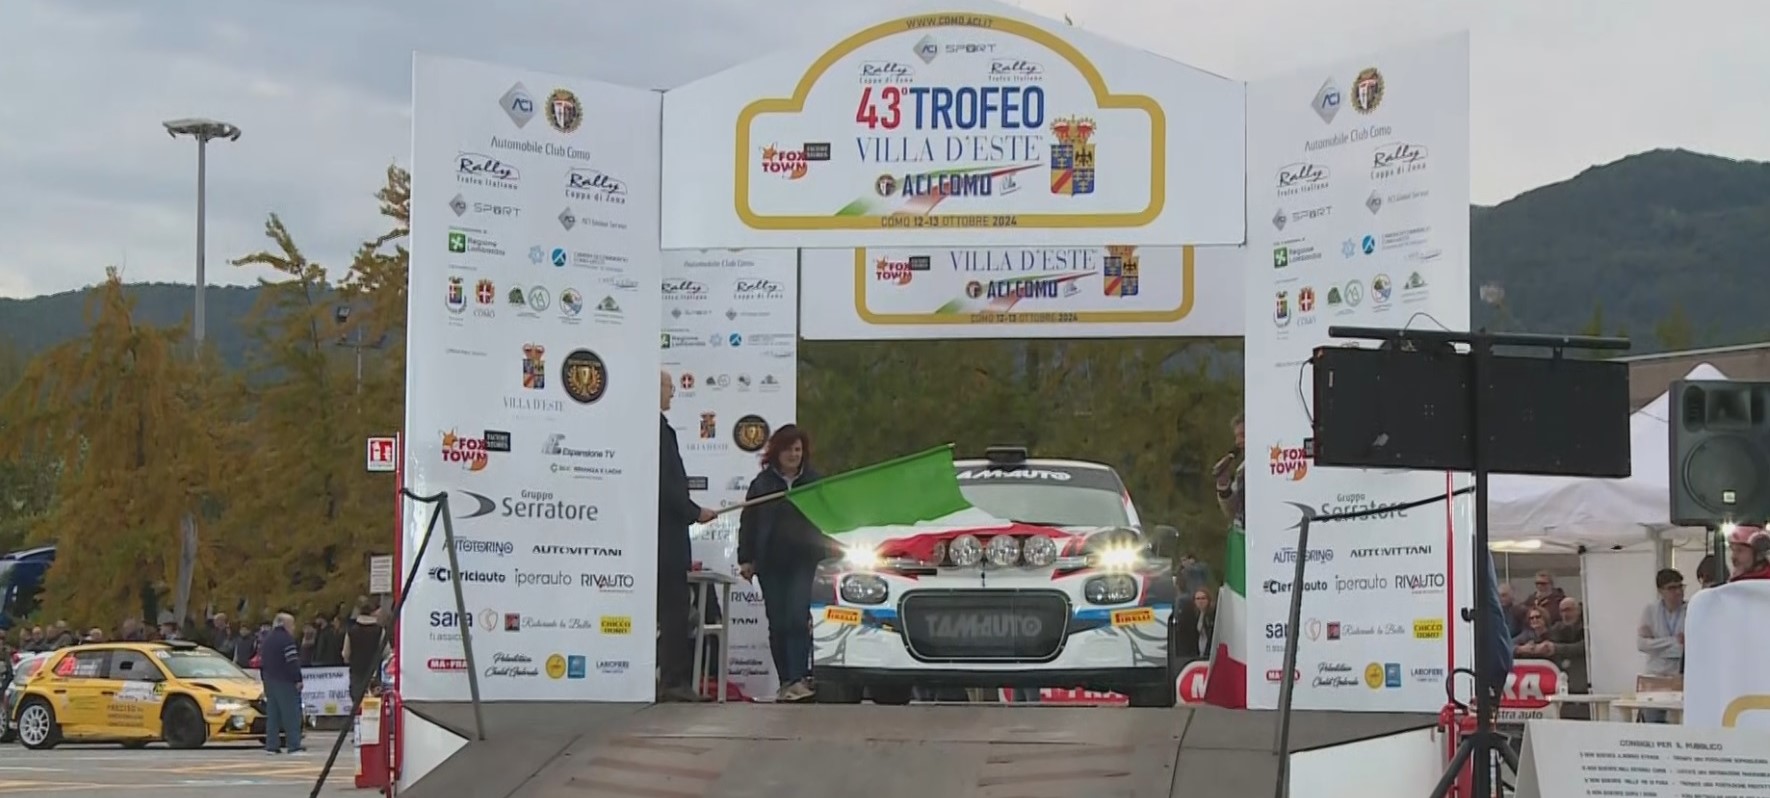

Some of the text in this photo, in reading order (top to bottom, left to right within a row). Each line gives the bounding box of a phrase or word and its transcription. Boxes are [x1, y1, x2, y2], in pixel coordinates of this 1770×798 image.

[921, 44, 937, 54] ACI
[945, 43, 997, 54] SPORT
[863, 62, 908, 76] Rally
[991, 59, 1037, 74] Rally
[511, 97, 533, 113] ACI
[1321, 91, 1341, 108] ACI
[909, 86, 1045, 130] TROFEO
[1304, 124, 1392, 153] Automobile Club Como
[490, 135, 591, 161] Automobile Club Como
[856, 134, 1042, 164] VILLA D'ESTE
[778, 151, 807, 163] FOX
[1374, 144, 1420, 168] Rally
[460, 157, 512, 179] Rally
[761, 161, 808, 175] TOWN
[1279, 163, 1323, 186] Rally
[1396, 164, 1406, 176] di
[569, 172, 620, 193] Rally
[901, 173, 993, 197] ACI COMO
[565, 189, 626, 205] Coppa di Zona
[473, 201, 521, 217] SPORT
[1291, 205, 1333, 222] SPORT
[881, 215, 1018, 228] COMO 12-13 OTTOBRE 2024
[721, 259, 736, 268] Club
[889, 261, 911, 271] FOX
[949, 249, 1012, 272] VILLA
[1020, 248, 1097, 271] D'ESTE
[876, 271, 913, 281] TOWN
[661, 280, 702, 294] Rally
[736, 279, 778, 292] Rally
[986, 279, 1058, 299] ACI COMO
[503, 395, 532, 410] VILLA
[458, 437, 488, 451] FOX
[441, 449, 488, 463] TOWN
[604, 449, 616, 459] TV
[1282, 448, 1307, 461] FOX
[955, 469, 1072, 481] AM-AUTO
[1270, 461, 1307, 475] TOWN
[521, 489, 553, 501] Gruppo
[1336, 492, 1366, 504] Gruppo
[501, 496, 599, 522] Serratore
[532, 544, 622, 557] AUTOVITTANI
[1273, 548, 1334, 565] AUTOORINO
[1350, 545, 1432, 559] AUTOVITTANI
[435, 566, 506, 584] Clriciauto
[515, 568, 572, 587] iperauto
[581, 572, 634, 588] RIVAUTO
[1394, 572, 1445, 590] RIVAUTO
[1269, 578, 1328, 594] Clerauto
[1335, 573, 1387, 594] iperauto
[731, 591, 765, 602] RIVAU
[827, 609, 860, 622] PIRELLI
[1114, 611, 1151, 624] PIRELLI
[1518, 709, 1543, 720] auto
[1619, 739, 1656, 749] CONSIGLI
[1656, 741, 1673, 749] PER
[1685, 742, 1723, 751] PUBBLICO
